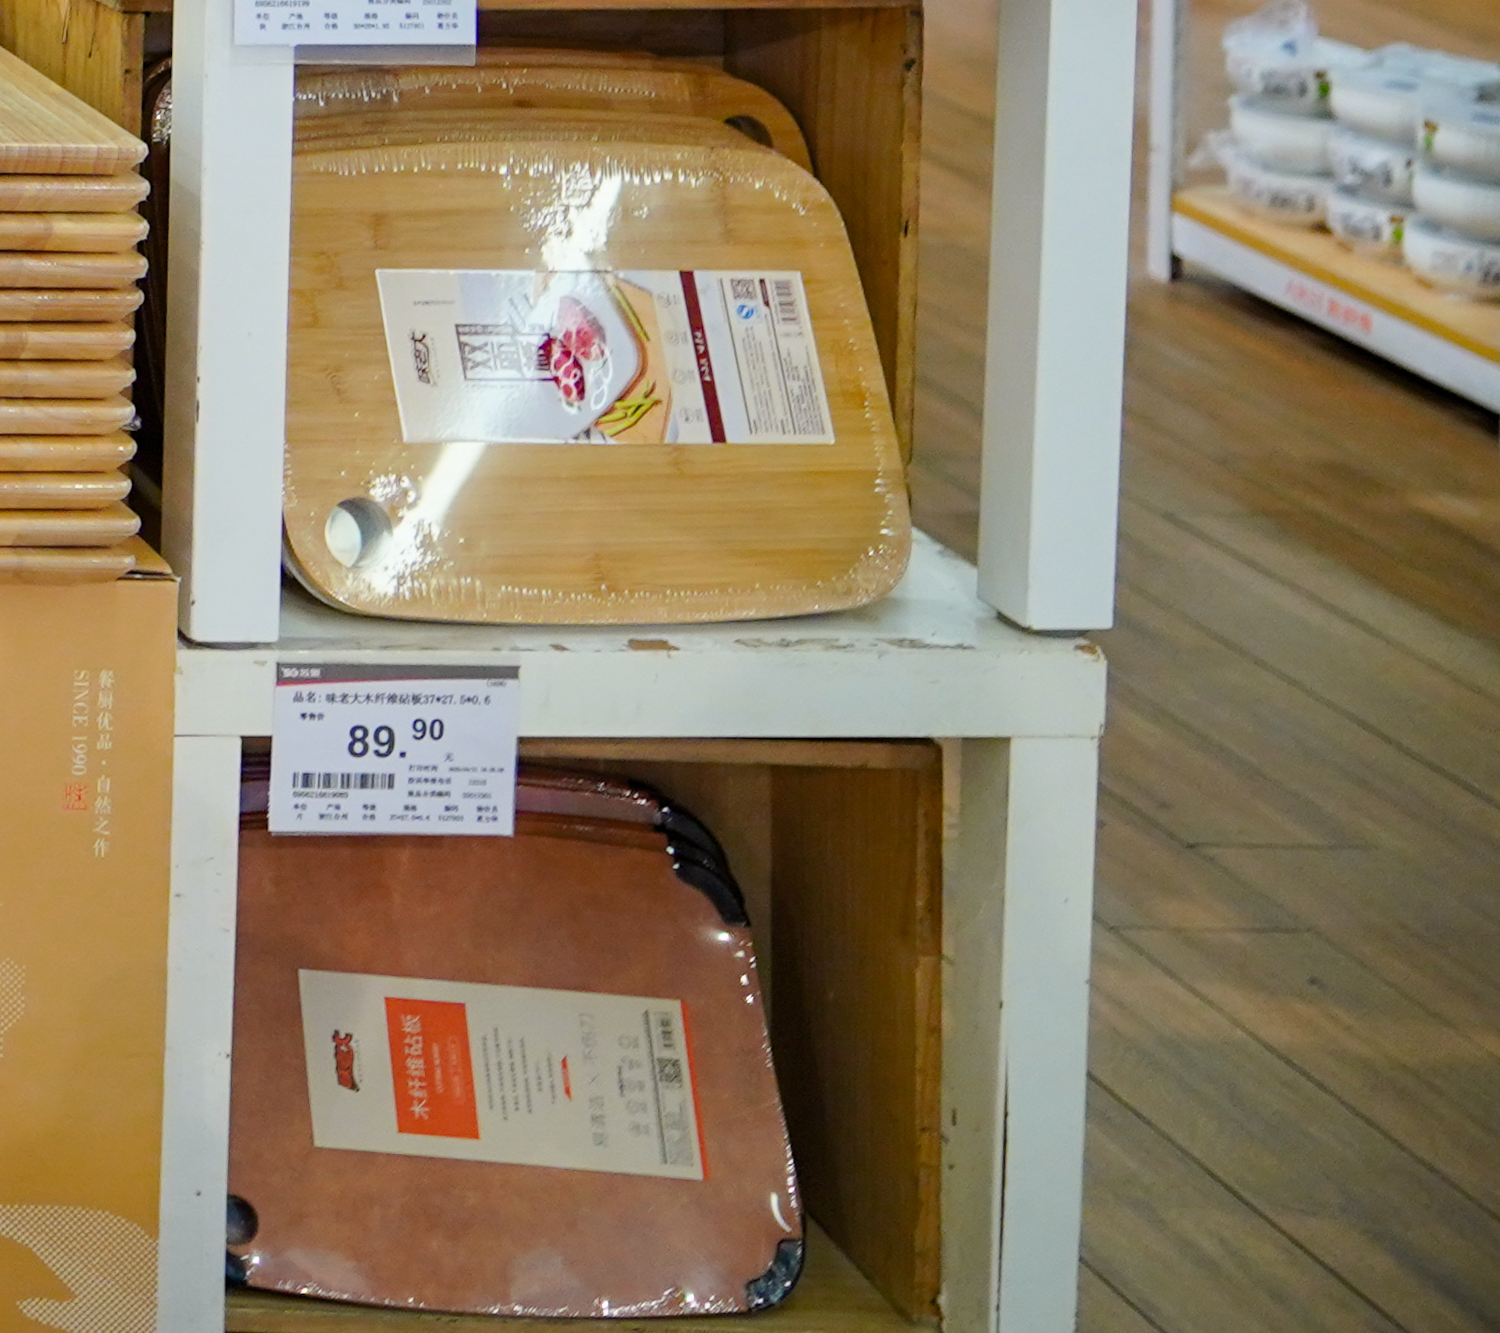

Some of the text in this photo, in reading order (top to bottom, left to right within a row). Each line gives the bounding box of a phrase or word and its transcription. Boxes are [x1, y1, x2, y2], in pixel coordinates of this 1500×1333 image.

[71, 669, 91, 775] SINCE 1990
[402, 1014, 429, 1120] 木纤维砧板
